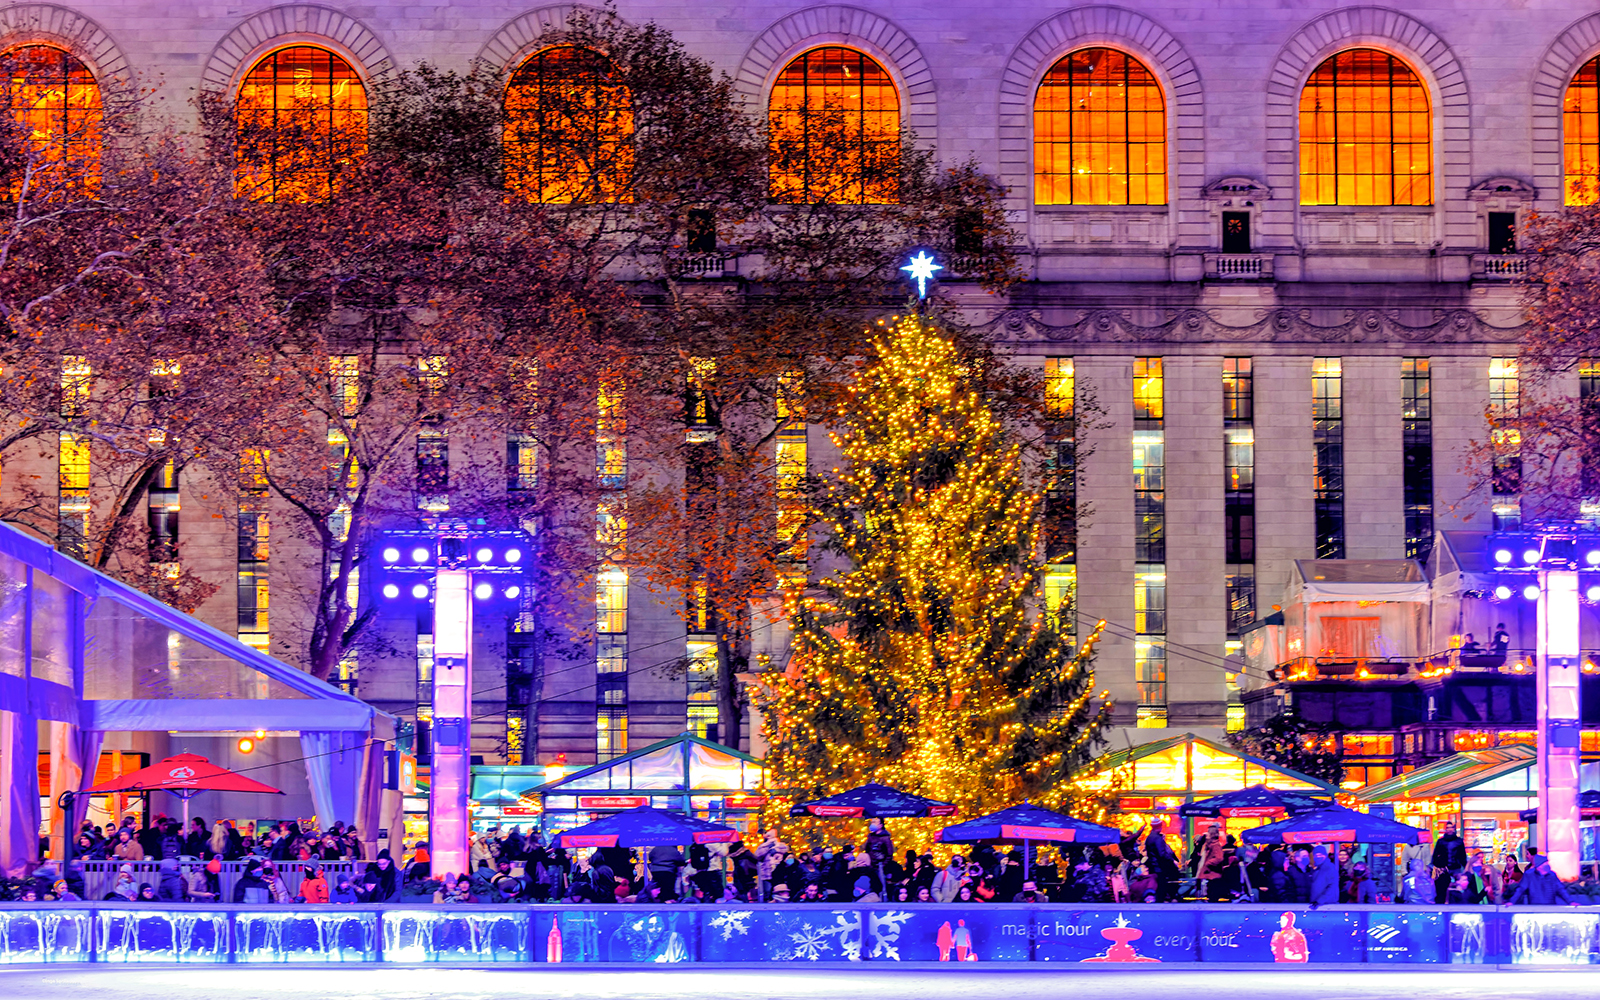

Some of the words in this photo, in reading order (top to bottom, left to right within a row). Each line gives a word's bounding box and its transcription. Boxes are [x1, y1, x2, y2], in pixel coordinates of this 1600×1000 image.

[1002, 921, 1050, 940] magic
[1055, 921, 1092, 936] hour
[1154, 935, 1196, 951] every
